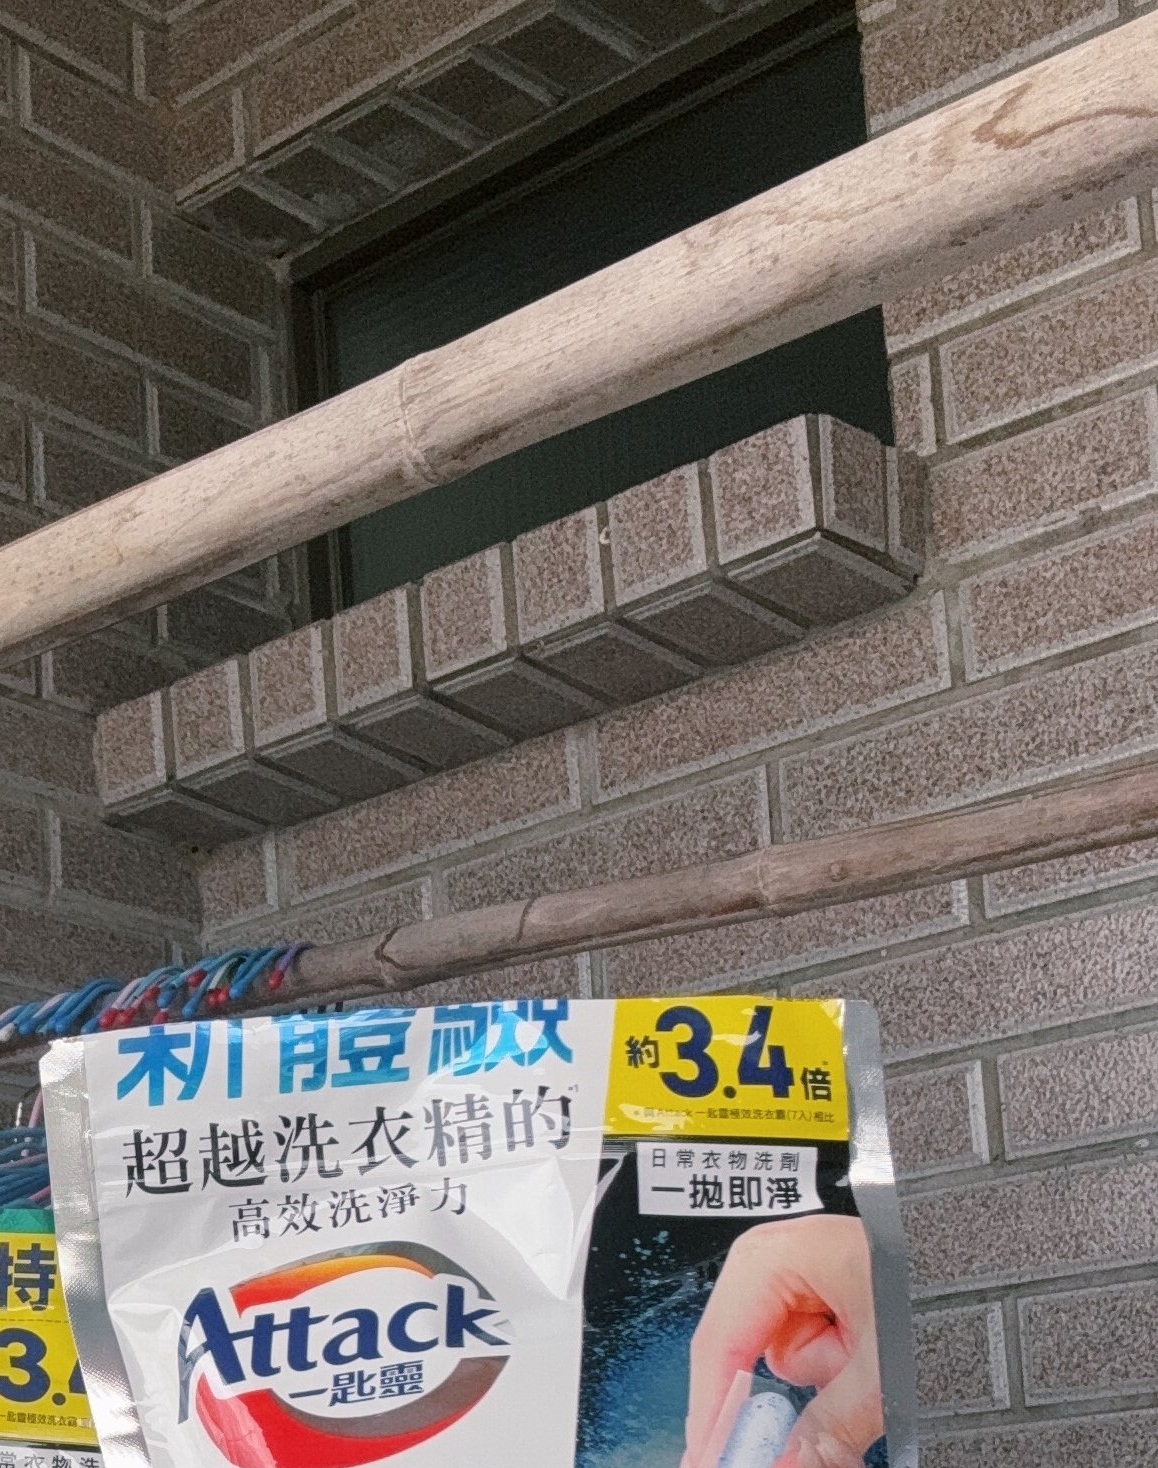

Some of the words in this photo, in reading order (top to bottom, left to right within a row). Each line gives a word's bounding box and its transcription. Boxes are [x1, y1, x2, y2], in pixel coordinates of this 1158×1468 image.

[651, 1148, 800, 1172] 日常衣物洗劑
[228, 1177, 468, 1243] 高效洗淨力
[177, 1284, 512, 1425] Attack
[289, 1361, 425, 1407] 一匙靈
